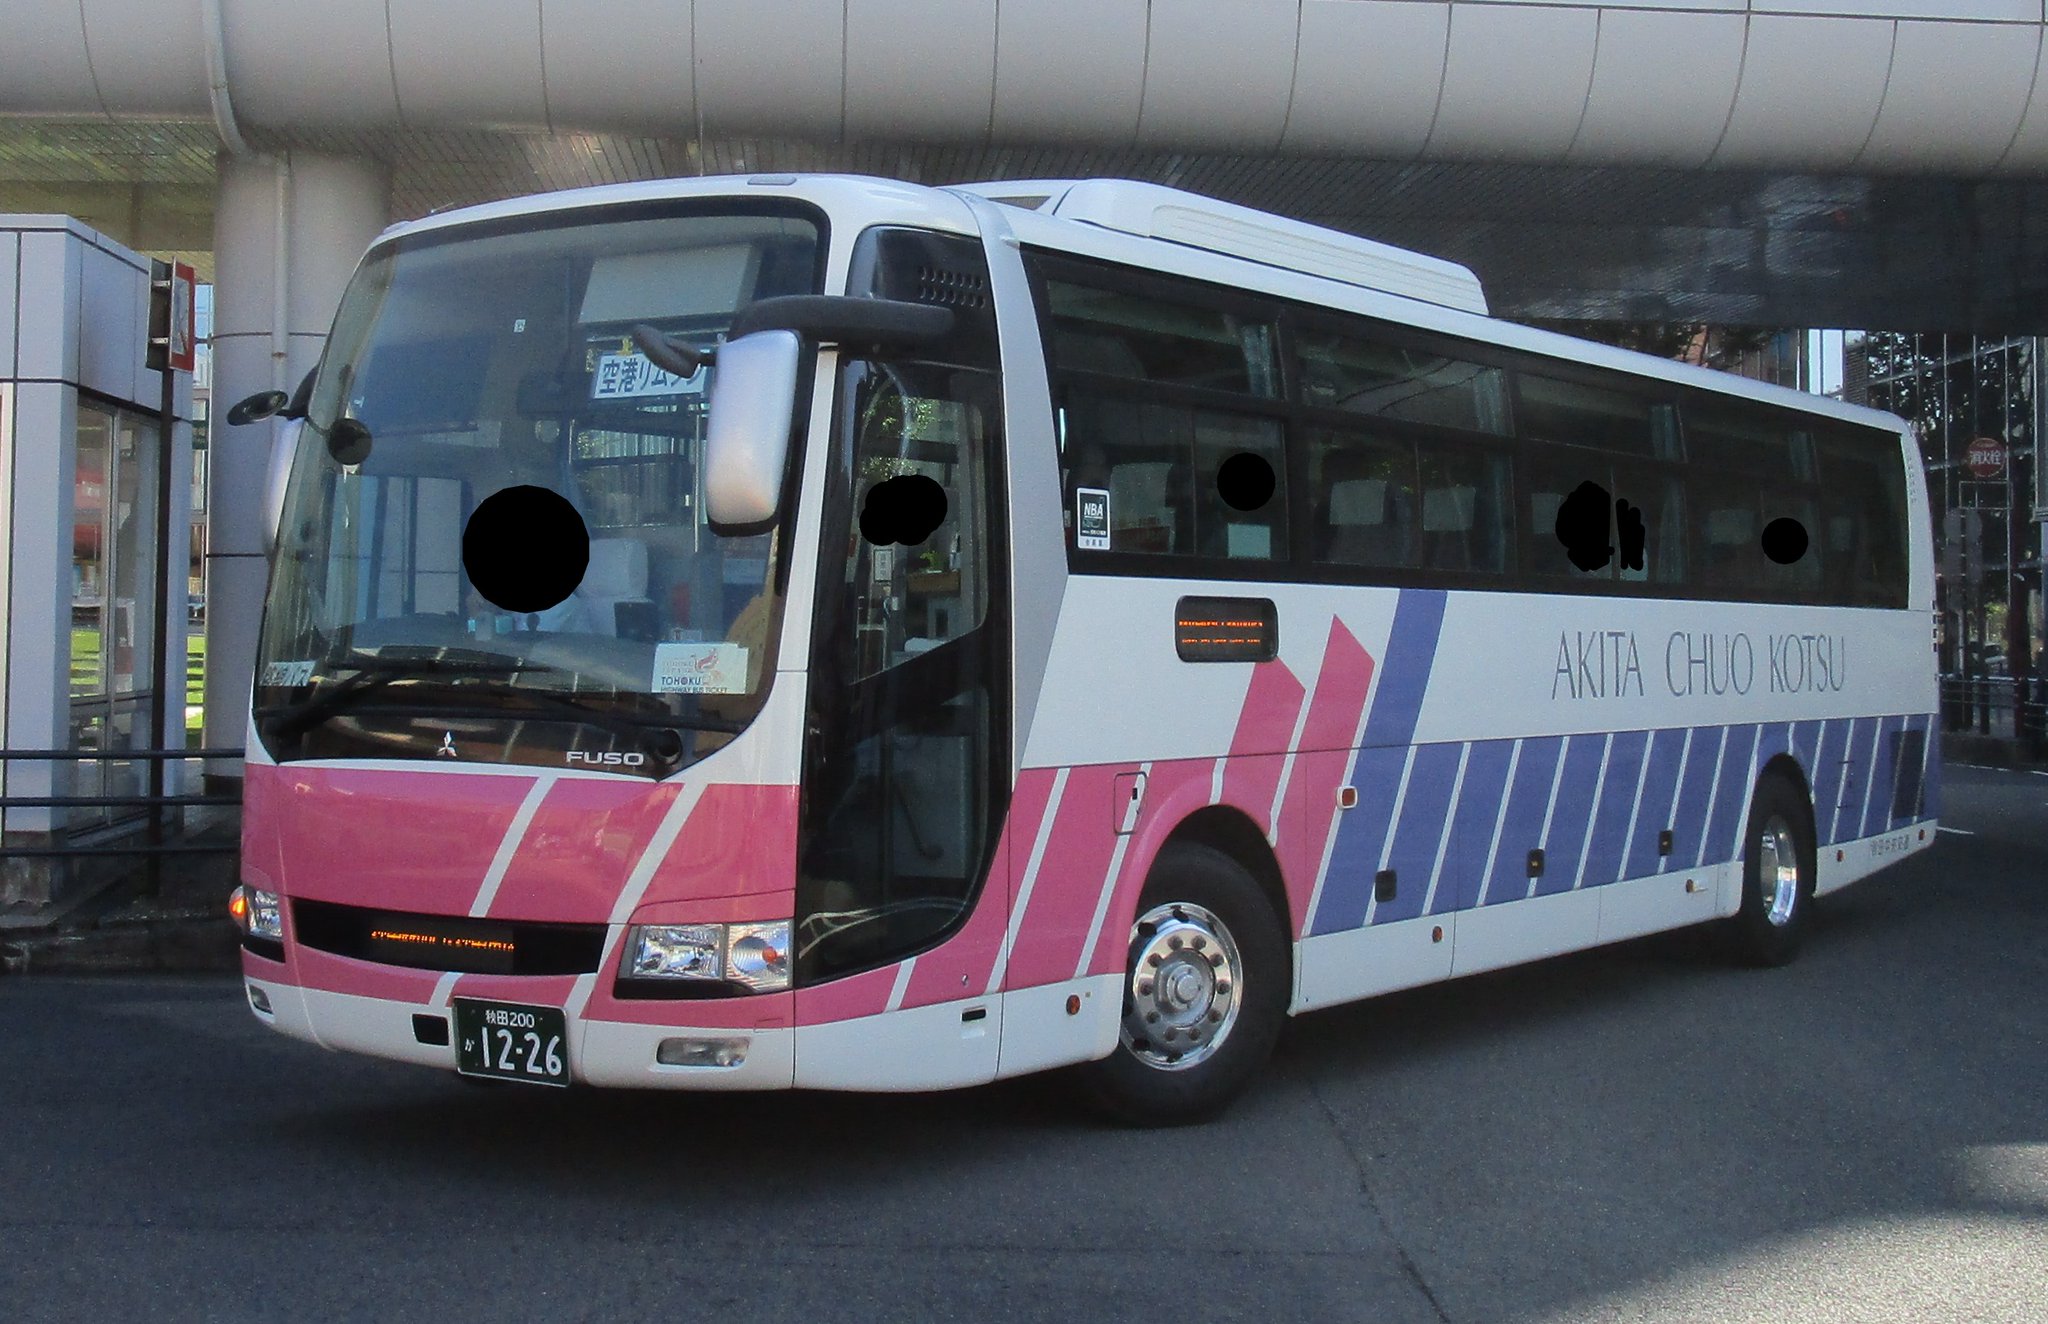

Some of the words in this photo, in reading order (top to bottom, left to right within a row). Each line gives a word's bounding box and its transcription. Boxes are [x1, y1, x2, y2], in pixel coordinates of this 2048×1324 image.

[1969, 449, 2002, 465] 消火栓
[1084, 502, 1104, 517] NBA
[1552, 630, 1644, 700] AKITA
[1666, 631, 1754, 697] CHUO
[1769, 633, 1845, 693] KOTSU
[661, 676, 701, 686] TOHOKU
[566, 751, 644, 766] FUSO
[485, 1009, 535, 1028] 秋田200
